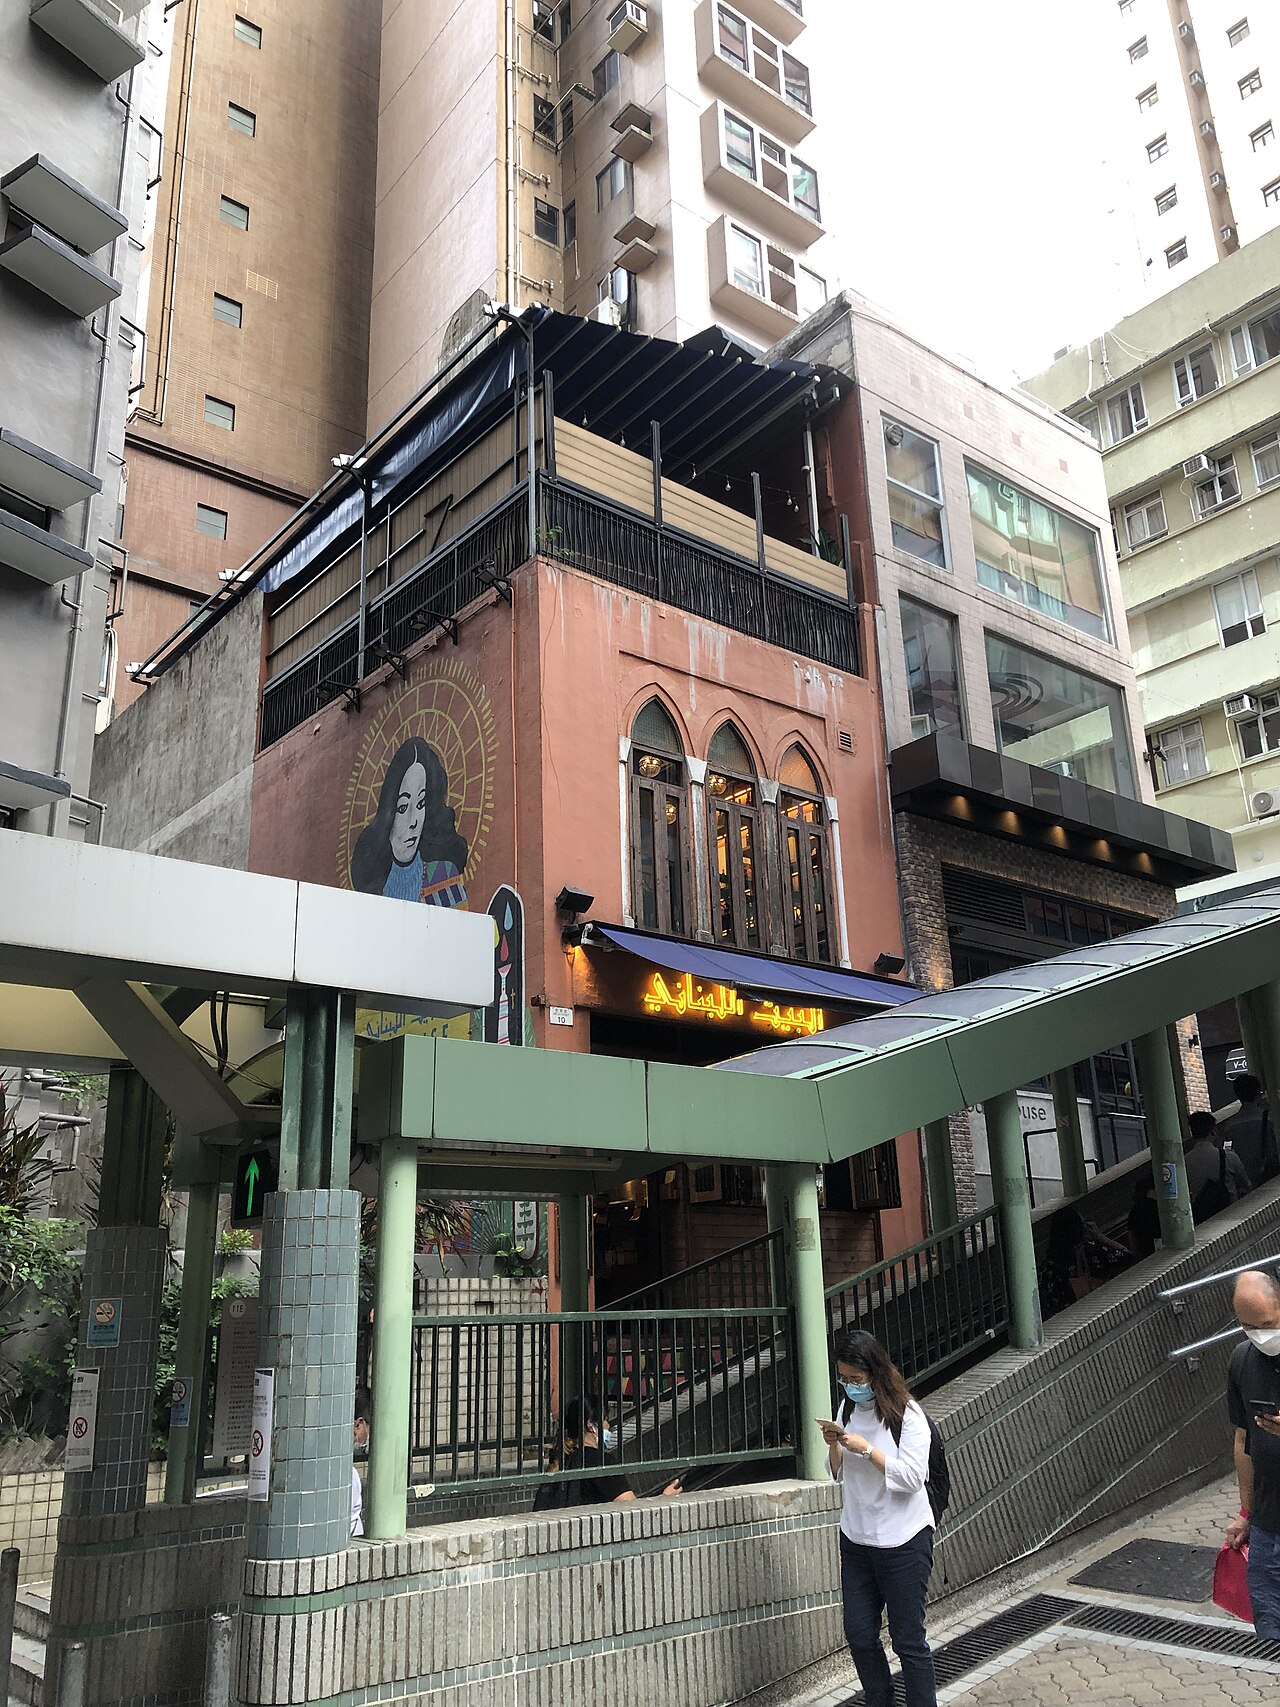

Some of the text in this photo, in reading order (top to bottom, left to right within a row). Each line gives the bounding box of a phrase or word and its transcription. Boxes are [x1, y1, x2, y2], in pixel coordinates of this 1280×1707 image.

[643, 972, 824, 1035] البيت اللبناني
[558, 1016, 566, 1024] 10
[1018, 1105, 1047, 1121] use
